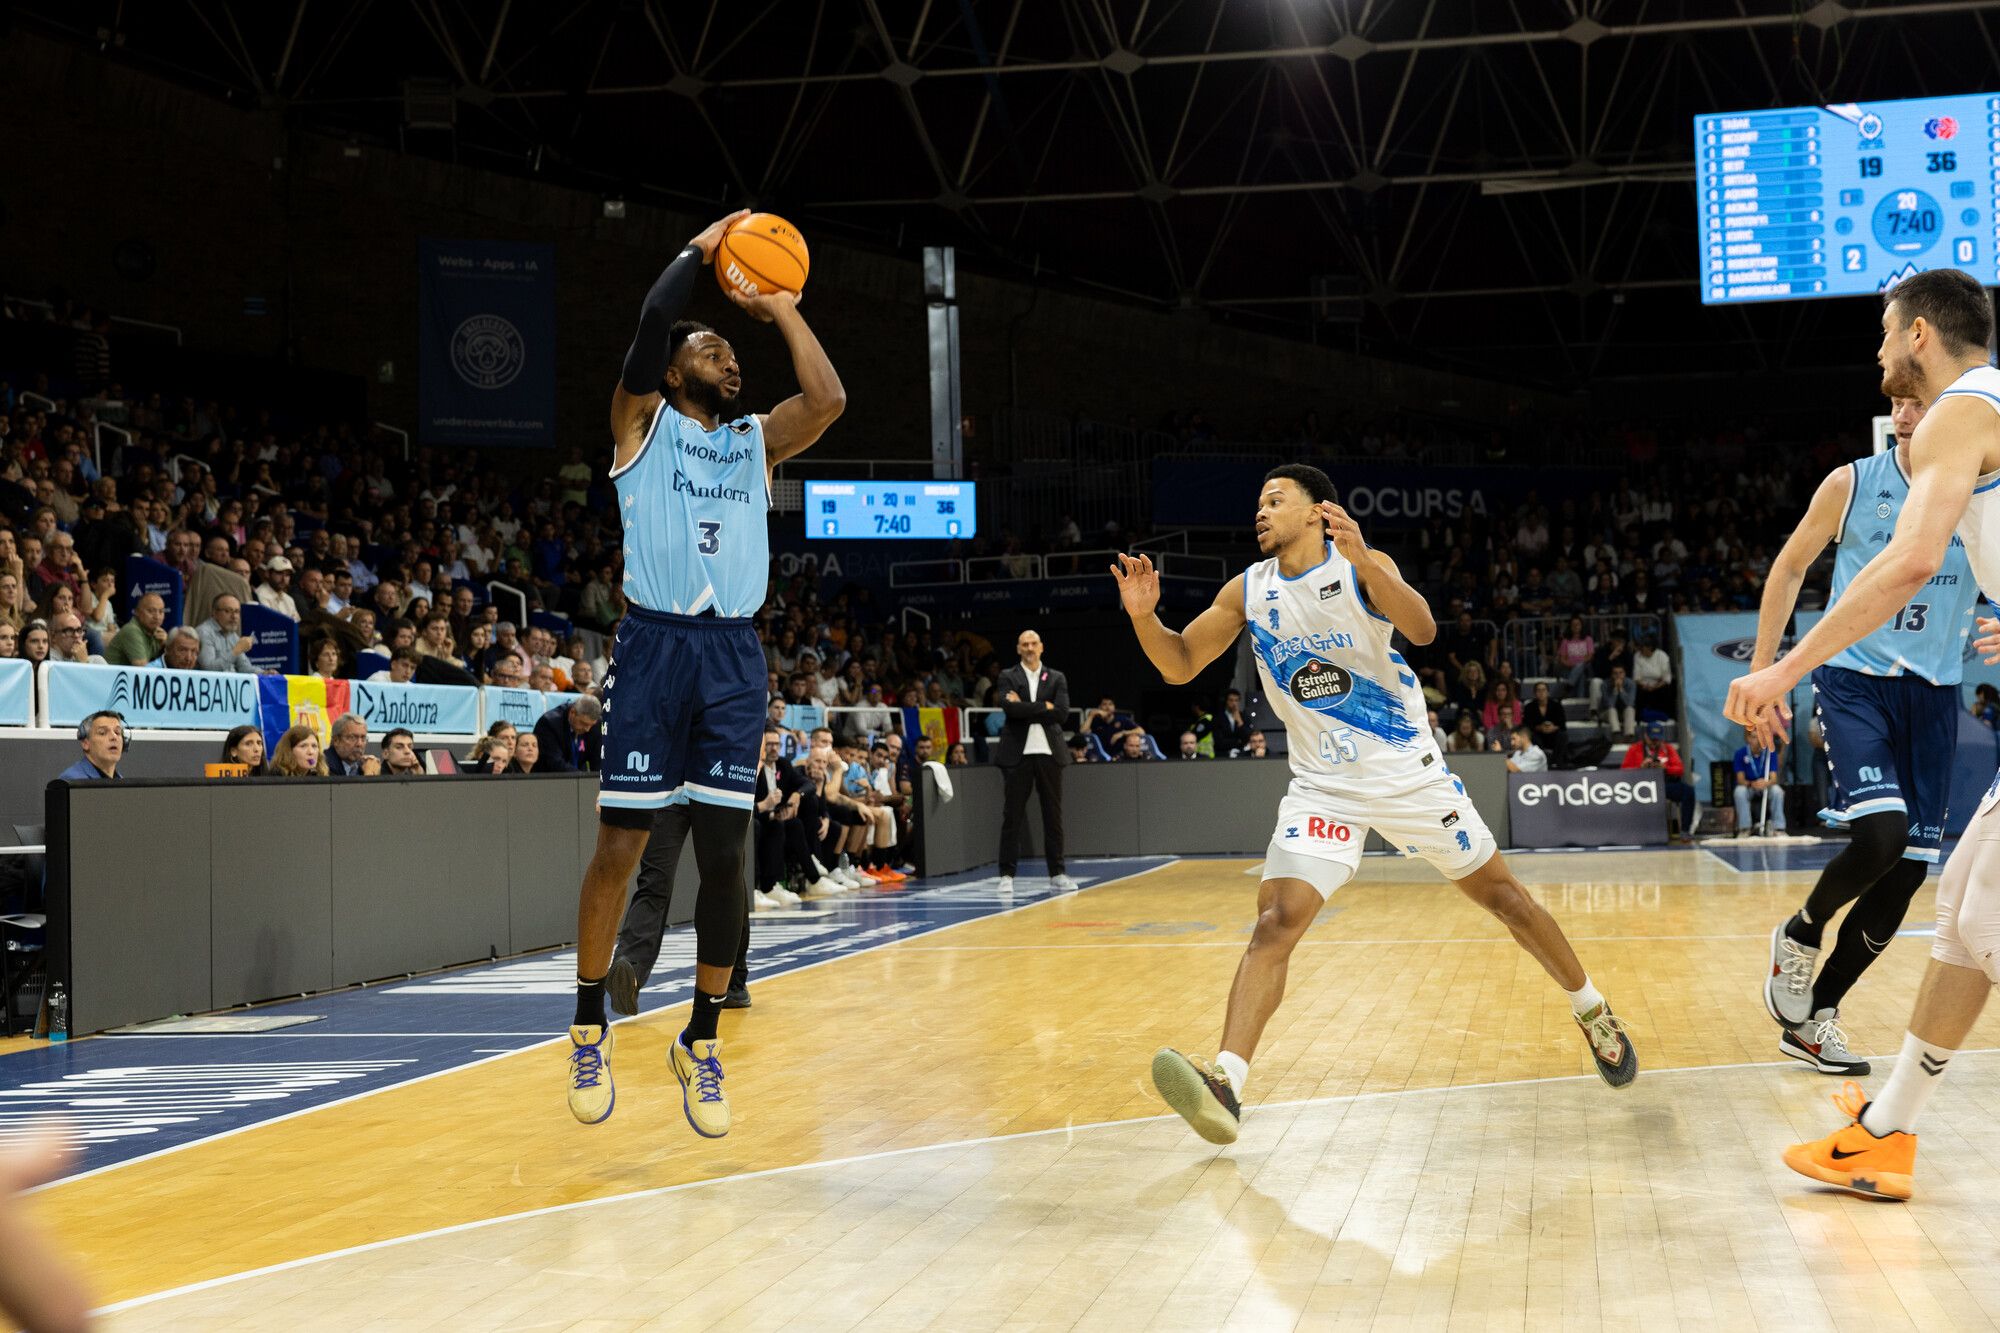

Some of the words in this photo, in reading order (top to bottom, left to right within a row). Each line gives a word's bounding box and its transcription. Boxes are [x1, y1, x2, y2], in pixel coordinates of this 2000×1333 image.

[1858, 156, 1883, 179] 19
[1926, 152, 1957, 173] 36
[1887, 210, 1936, 236] 7:40
[437, 256, 474, 268] Webs
[483, 257, 516, 272] Apps
[1847, 249, 1861, 270] 2
[1958, 241, 1971, 262] 0
[686, 480, 751, 505] Andorra
[1347, 486, 1489, 519] OCURSA
[821, 500, 836, 514] 19
[936, 500, 955, 514] 36
[874, 514, 911, 533] 7:40
[698, 521, 721, 556] 3
[1893, 603, 1930, 632] 13
[1270, 627, 1354, 666] BREOGÁN
[133, 674, 251, 713] MORABANC
[1298, 671, 1340, 689] Estrella
[1301, 683, 1342, 699] Galicia
[374, 691, 439, 725] Andorra
[1319, 726, 1358, 765] 45
[609, 774, 639, 783] Andorra
[640, 774, 648, 783] la
[1517, 776, 1658, 807] endesa
